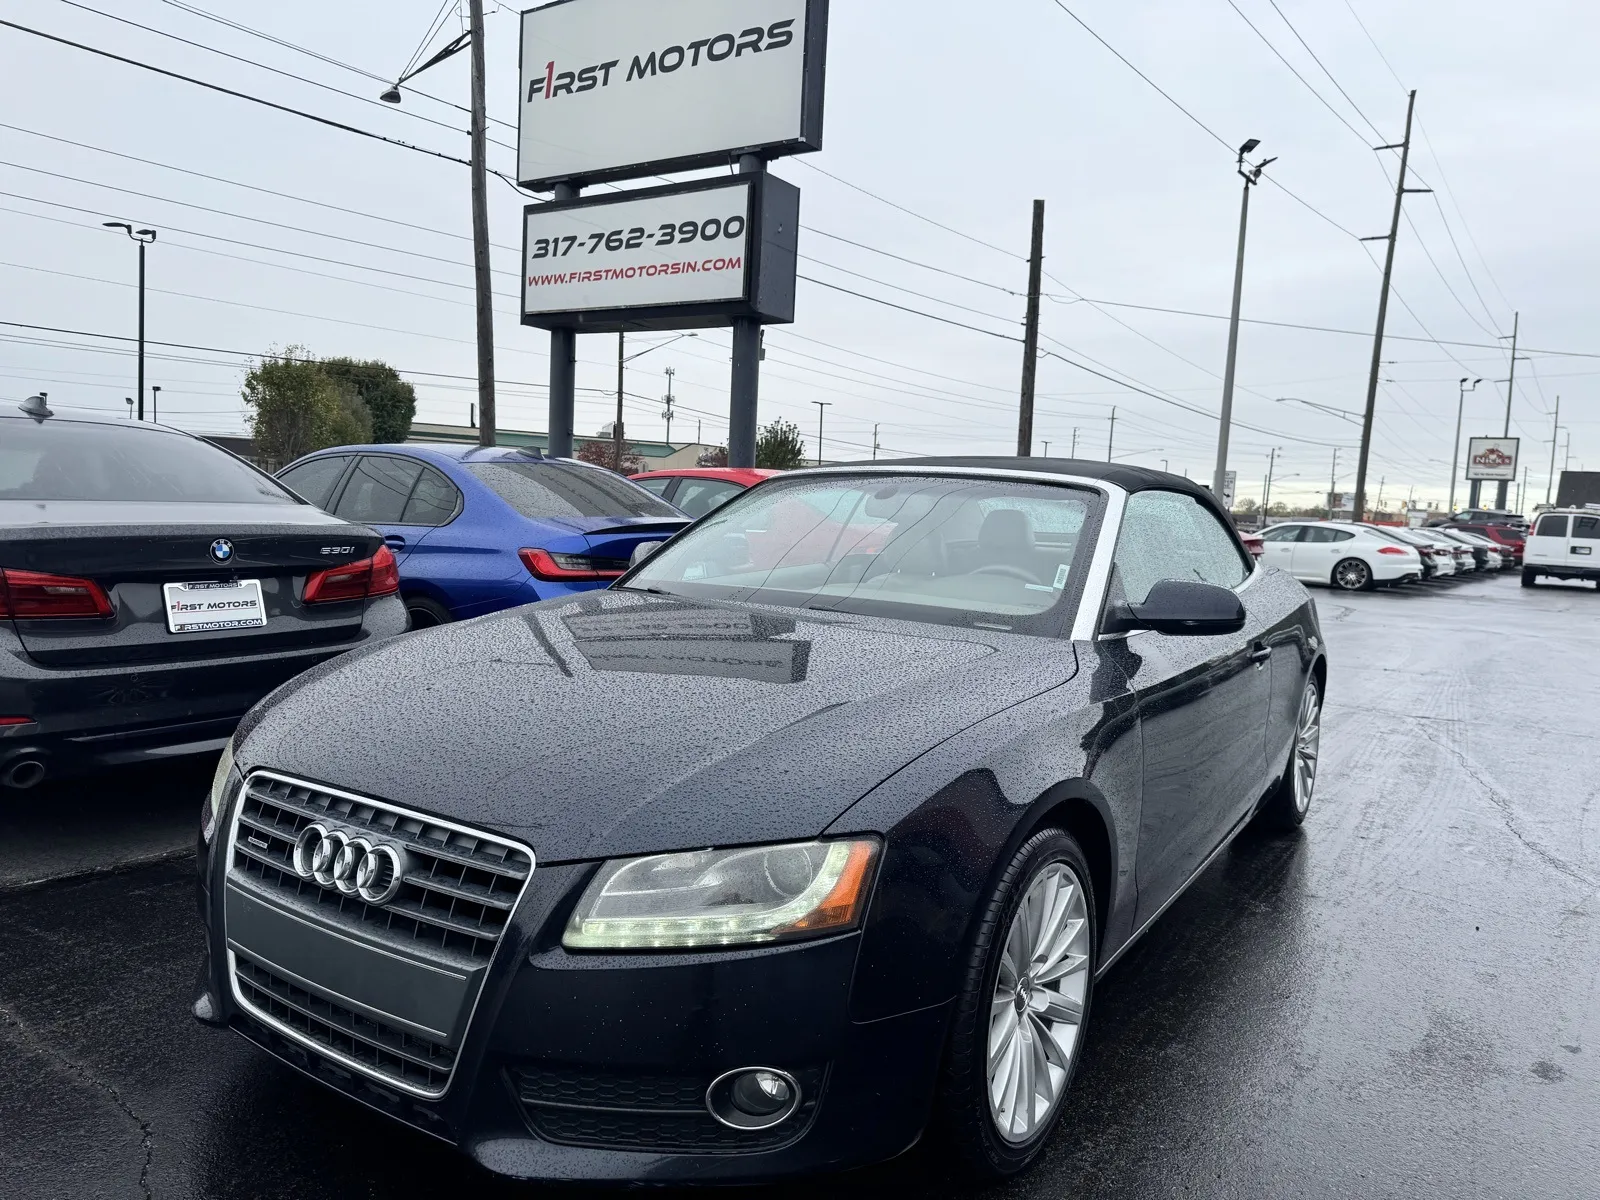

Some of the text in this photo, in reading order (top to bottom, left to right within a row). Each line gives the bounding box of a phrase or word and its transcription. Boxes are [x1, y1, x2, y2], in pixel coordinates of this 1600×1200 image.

[625, 18, 796, 82] MOTORS
[531, 215, 746, 260] 317-762-3900
[527, 256, 742, 288] WWW.FIRSTMOTORSIN.COM
[209, 581, 239, 589] MOTORS
[206, 599, 257, 610] MOTORS
